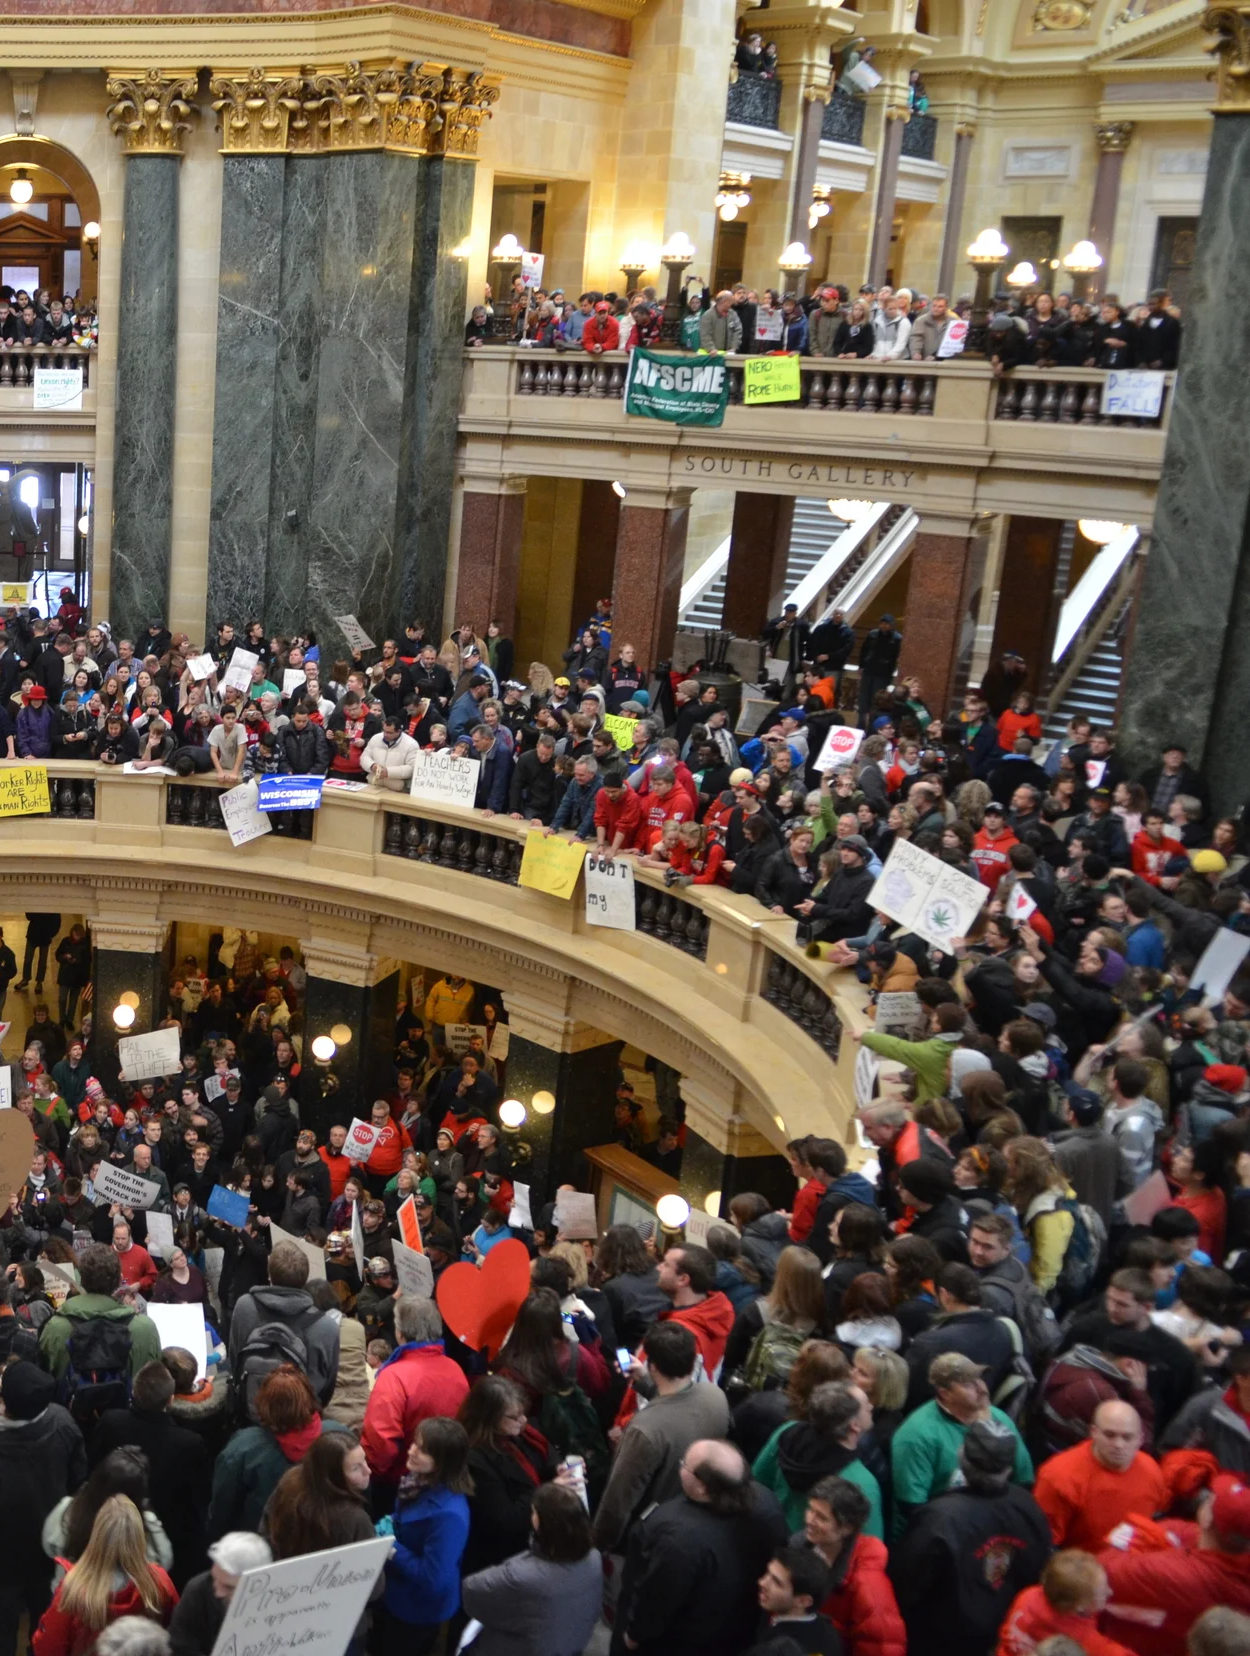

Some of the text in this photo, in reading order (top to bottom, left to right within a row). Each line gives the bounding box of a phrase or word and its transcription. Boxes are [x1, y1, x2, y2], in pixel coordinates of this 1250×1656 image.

[633, 358, 726, 394] AFSCME
[747, 384, 772, 398] ROME
[685, 455, 914, 487] SOUTH GALLERY
[831, 735, 855, 747] STOP
[421, 753, 471, 774] TEACHERS
[417, 767, 428, 777] DO
[431, 770, 446, 779] NOT
[7, 787, 25, 797] ARE
[260, 789, 320, 800] WISCONSIN
[21, 795, 49, 811] Rights
[290, 797, 318, 808] BEST
[588, 893, 607, 912] my
[127, 1048, 165, 1062] TO THE
[127, 1058, 171, 1078] THIEF
[354, 1128, 373, 1141] STOP
[104, 1175, 148, 1197] GOVERNOR'S
[113, 1170, 145, 1187] STOP THE
[104, 1185, 129, 1200] ATTACK
